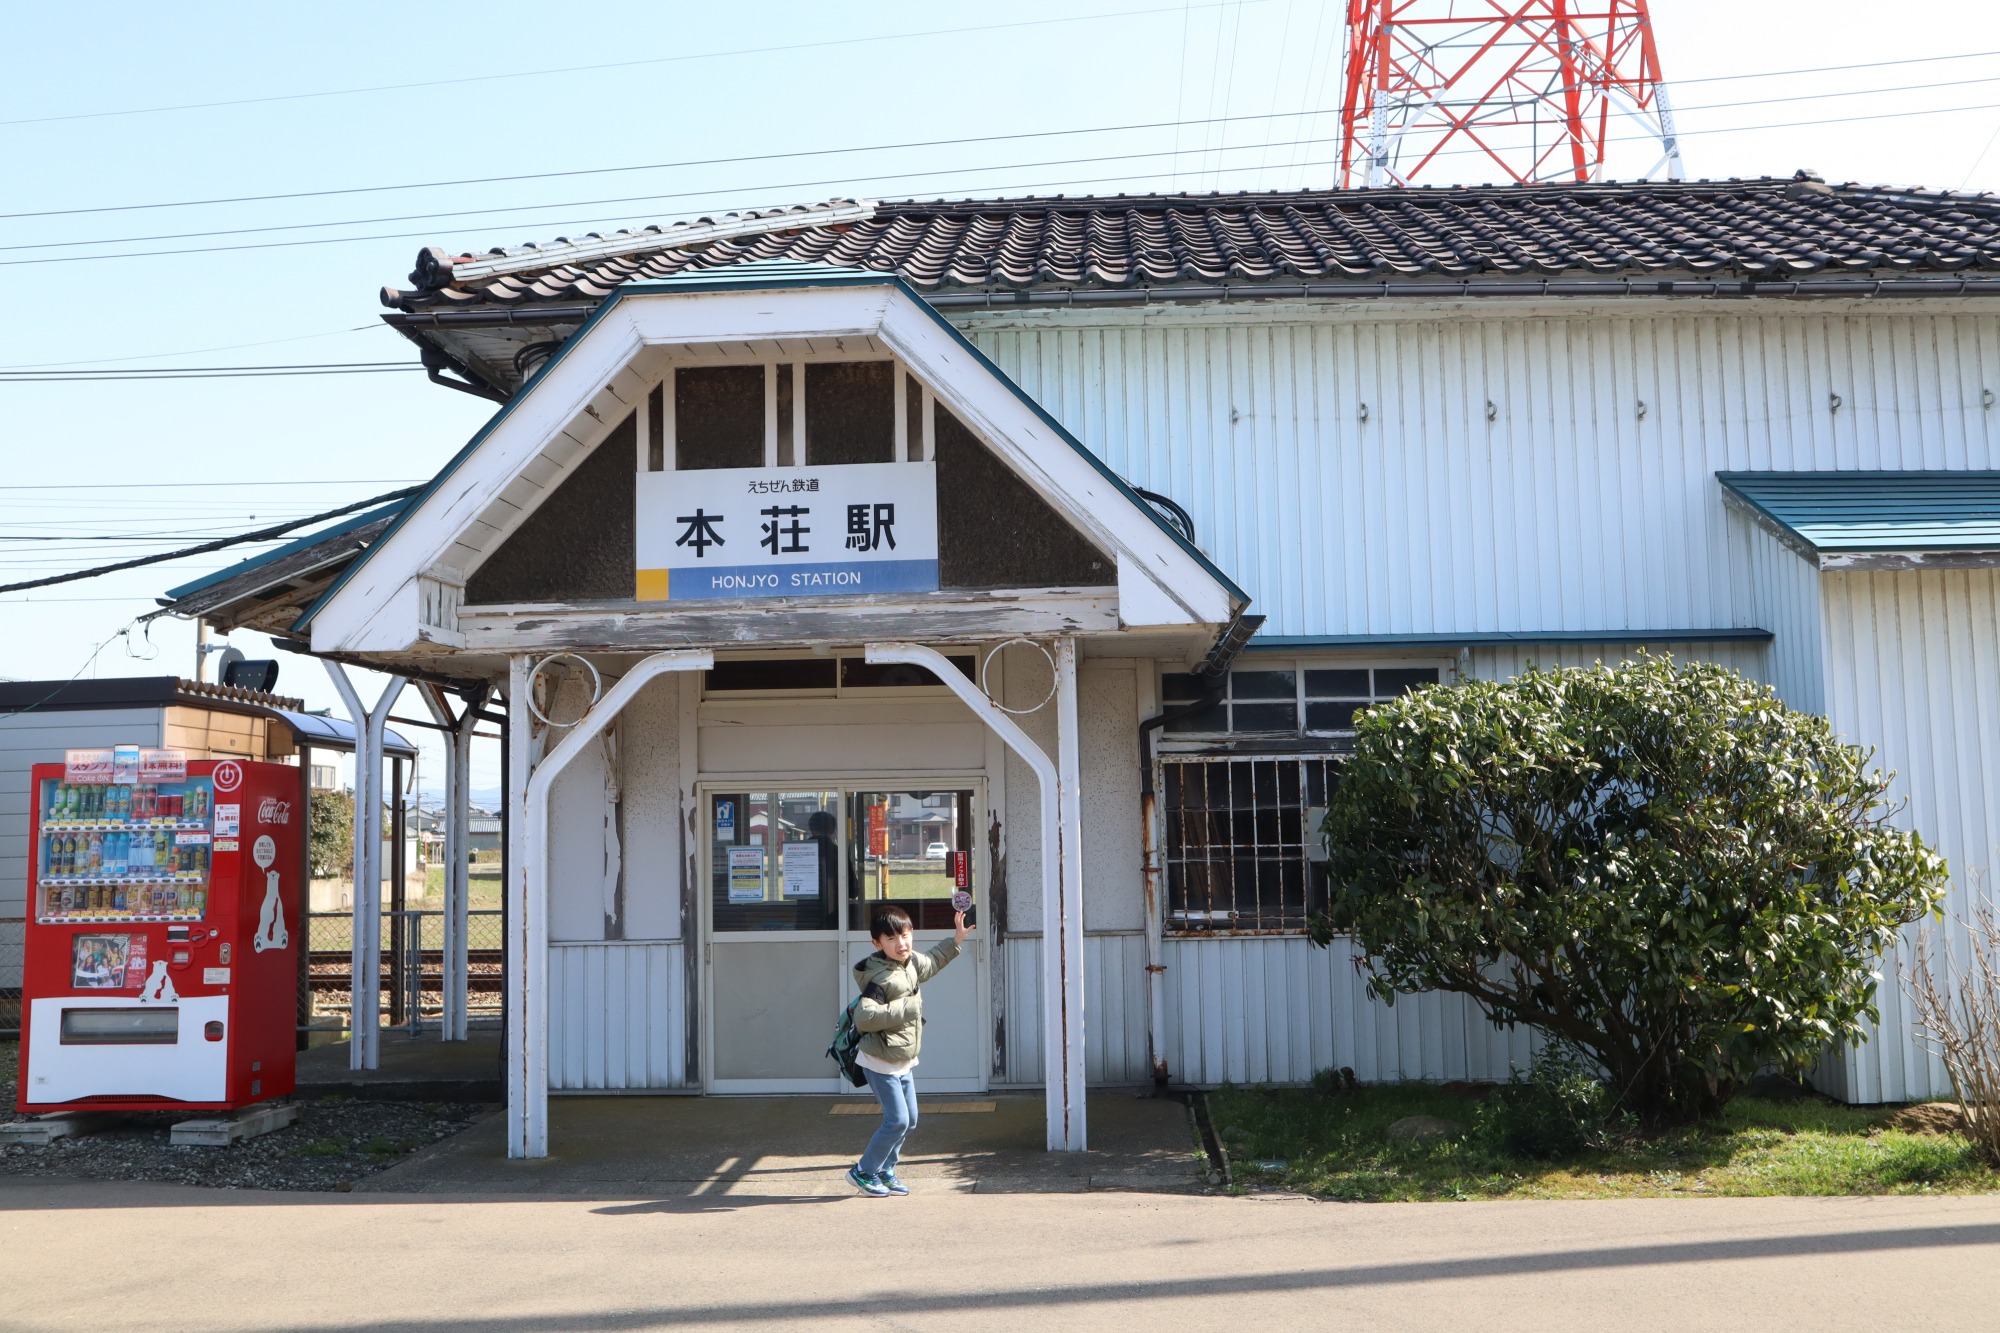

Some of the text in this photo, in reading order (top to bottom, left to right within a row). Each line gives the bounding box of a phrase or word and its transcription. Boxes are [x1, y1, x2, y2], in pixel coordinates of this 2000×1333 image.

[747, 478, 820, 494] えちぜん鉄道
[675, 503, 897, 558] 本荘駅
[711, 571, 862, 589] HONJYO STATION
[76, 774, 96, 782] Coke
